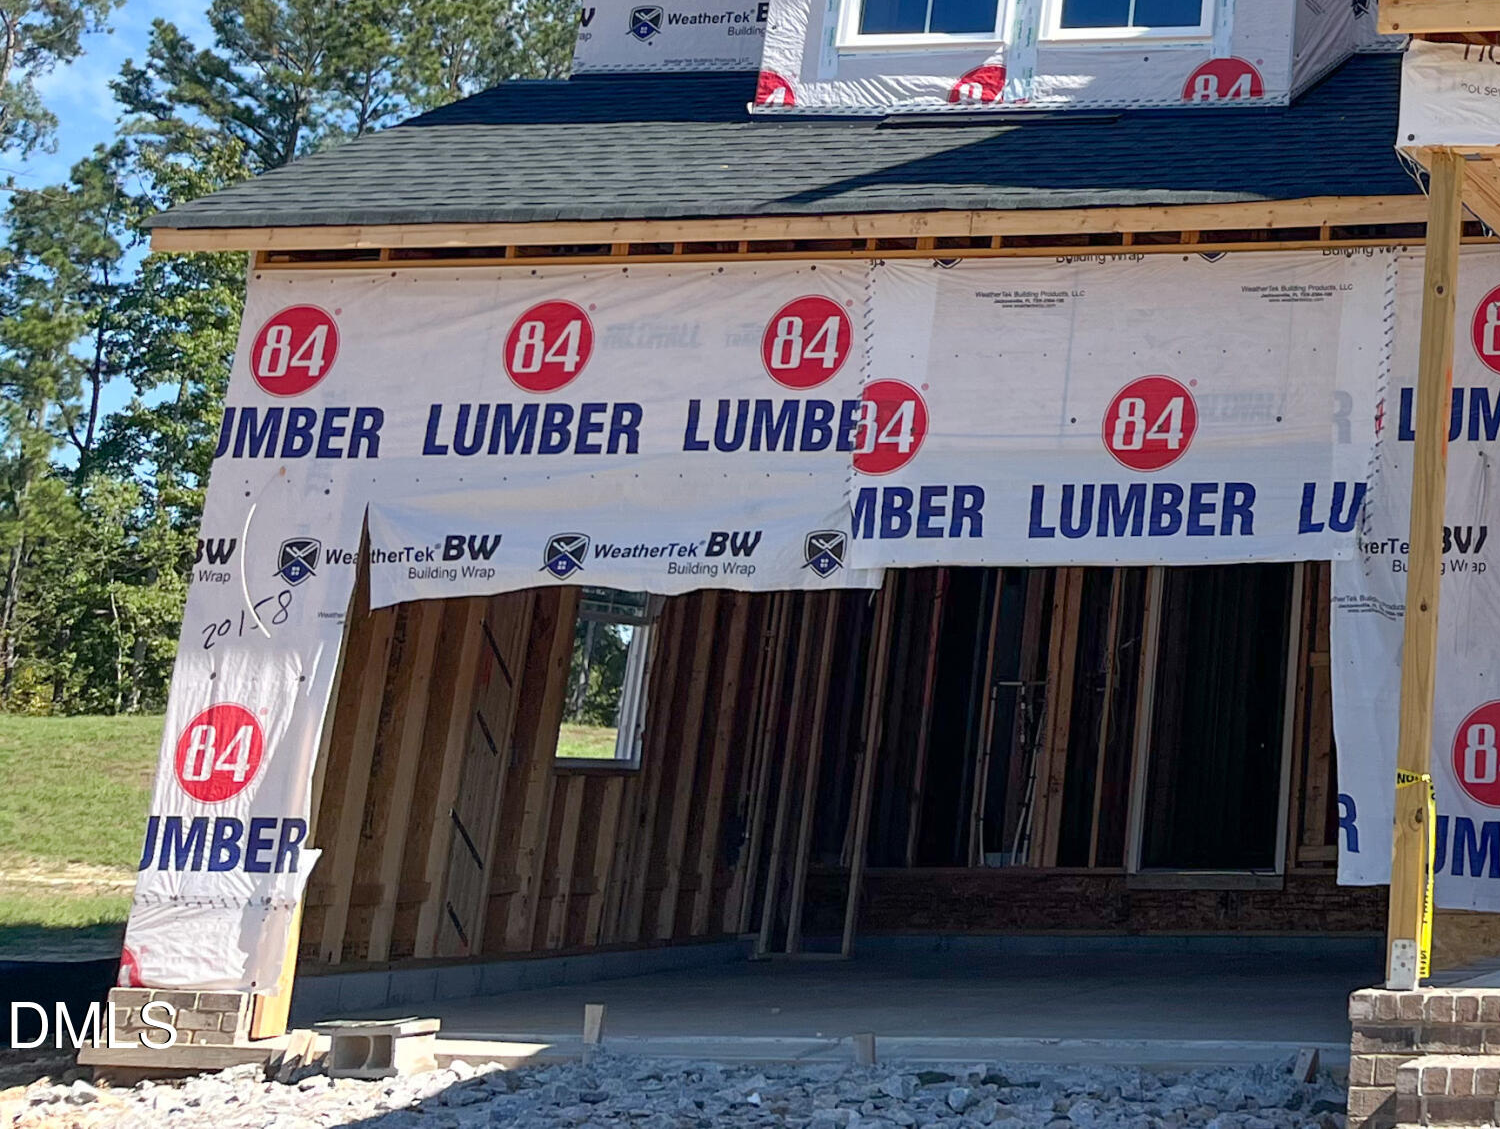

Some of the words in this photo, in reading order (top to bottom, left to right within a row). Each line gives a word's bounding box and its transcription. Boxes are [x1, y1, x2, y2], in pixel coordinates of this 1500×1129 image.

[668, 12, 750, 25] WeatherTek
[259, 324, 328, 377] 84
[511, 320, 580, 373] 84
[771, 316, 840, 369] 84
[422, 402, 643, 456] LUMBER
[1112, 397, 1184, 450] 84
[1028, 481, 1256, 538] LUMBER
[442, 534, 502, 562] BW
[594, 540, 699, 560] WeatherTek
[705, 530, 762, 557] BW
[667, 561, 719, 579] Building
[723, 561, 756, 577] Wrap
[199, 570, 231, 585] Wrap
[407, 565, 462, 583] Building
[465, 564, 496, 580] Wrap
[183, 724, 250, 782] 84
